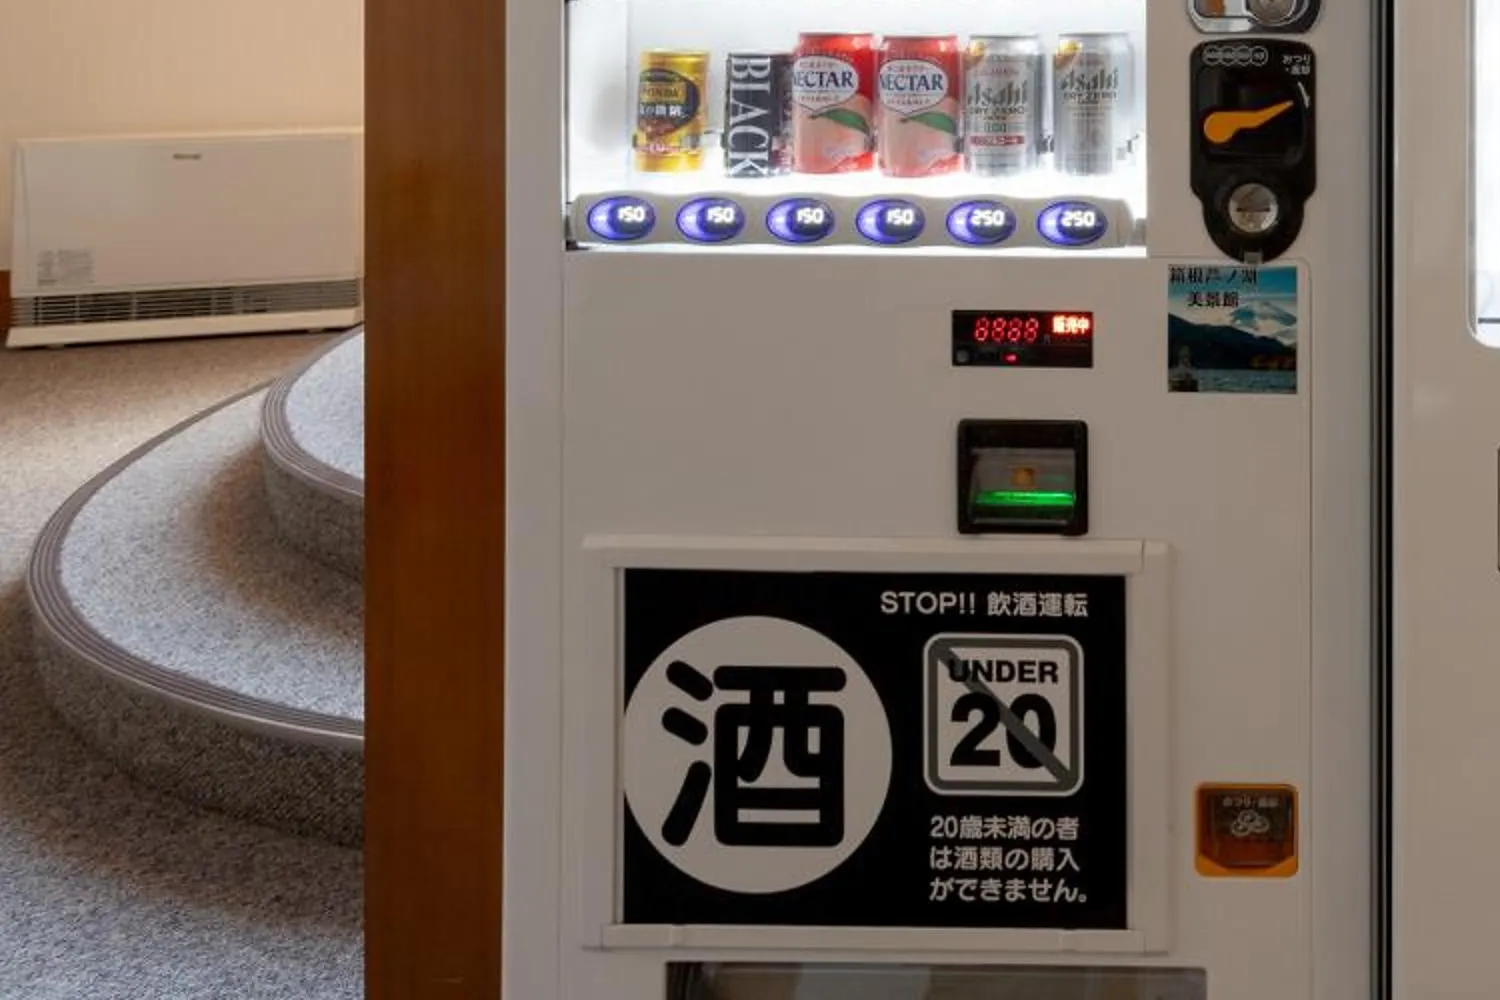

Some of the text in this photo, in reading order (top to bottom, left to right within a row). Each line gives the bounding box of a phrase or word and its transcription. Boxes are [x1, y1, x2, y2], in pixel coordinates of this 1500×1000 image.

[880, 73, 943, 92] NECTAR
[729, 57, 771, 177] BLACK
[618, 207, 645, 223] 150
[707, 207, 735, 223] 150
[797, 208, 824, 224] 150
[887, 208, 914, 225] 150
[970, 209, 1005, 226] 250
[1061, 210, 1095, 227] 250
[1169, 267, 1258, 284] 箱根芦ノ湖
[880, 591, 1089, 618] STOP!! 飲酒運転
[948, 659, 1059, 684] UNDER
[949, 692, 1057, 769] 20
[661, 659, 847, 848] 酒
[930, 815, 1080, 840] 20歳未満の者
[930, 846, 1080, 871] は酒類の購入
[929, 877, 1088, 903] ができません。
